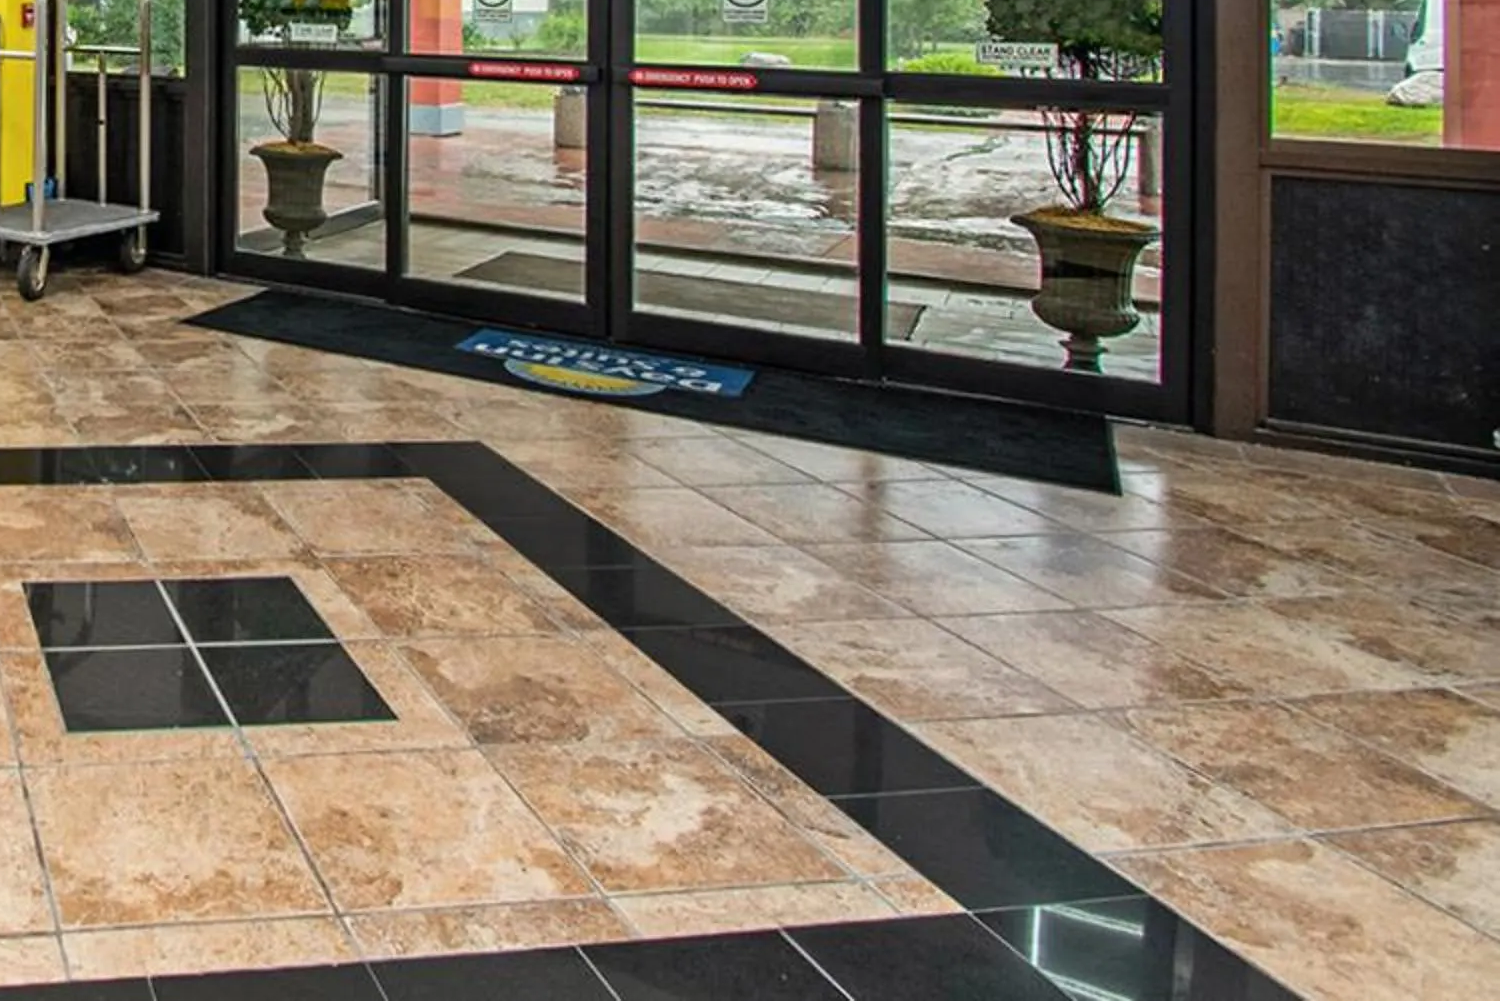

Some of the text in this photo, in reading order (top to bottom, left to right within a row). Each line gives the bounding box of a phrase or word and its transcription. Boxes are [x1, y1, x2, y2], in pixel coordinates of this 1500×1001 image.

[981, 45, 1050, 55] STAND CLEAR
[473, 342, 723, 393] Days Inn
